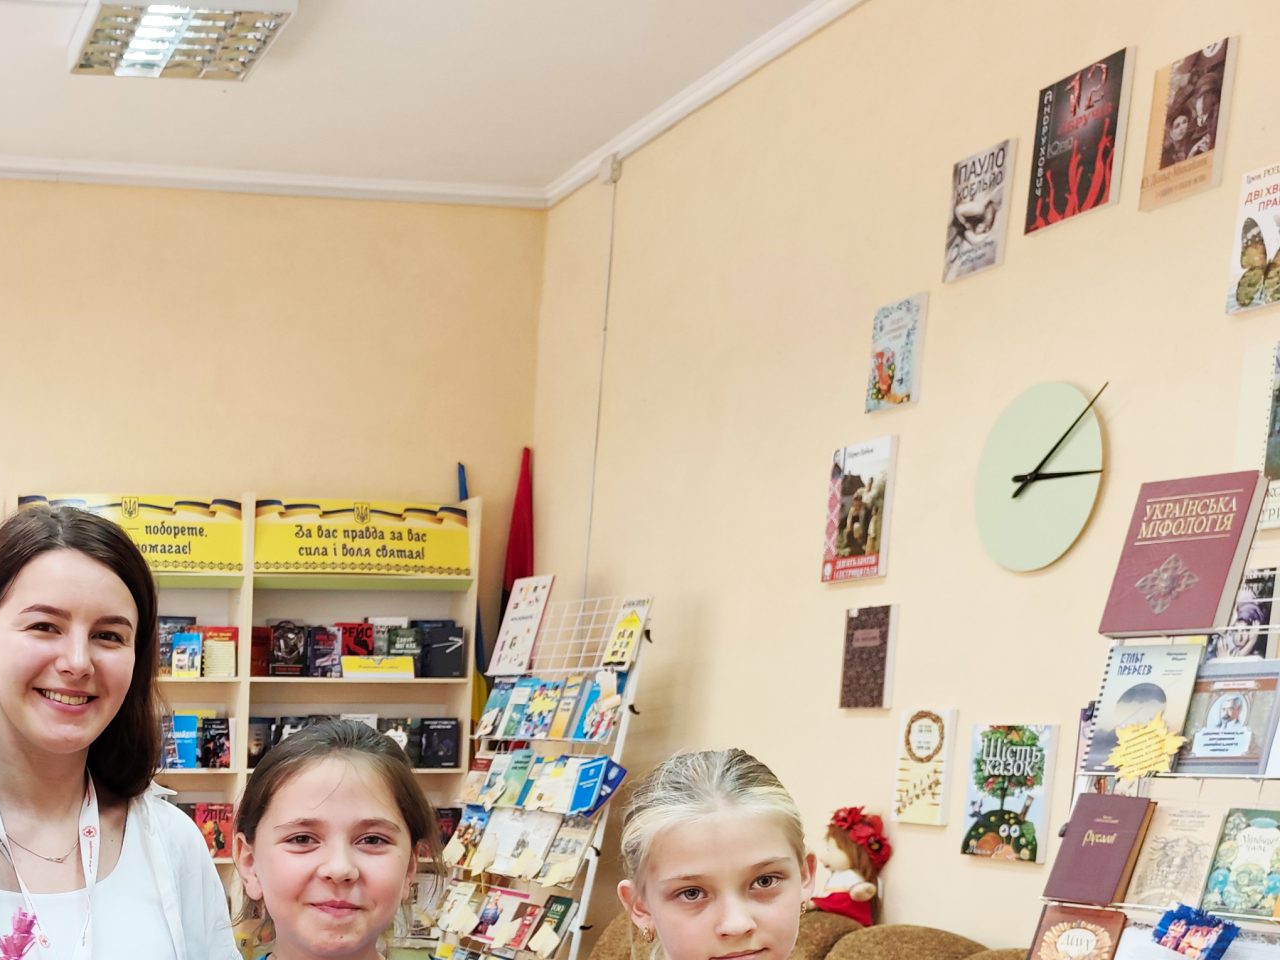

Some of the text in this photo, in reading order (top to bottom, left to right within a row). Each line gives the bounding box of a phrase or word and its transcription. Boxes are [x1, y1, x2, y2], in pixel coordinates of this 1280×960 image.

[1065, 63, 1108, 117] 12
[959, 147, 1005, 184] ПАУЛО
[1143, 496, 1237, 521] УКРАЇНСЬКА
[294, 524, 427, 542] За вас правда за вас
[1137, 513, 1235, 539] МІФОЛОГІЯ
[298, 543, 425, 560] сила і воля святая!
[982, 737, 1041, 763] Шість
[984, 759, 1034, 776] казок
